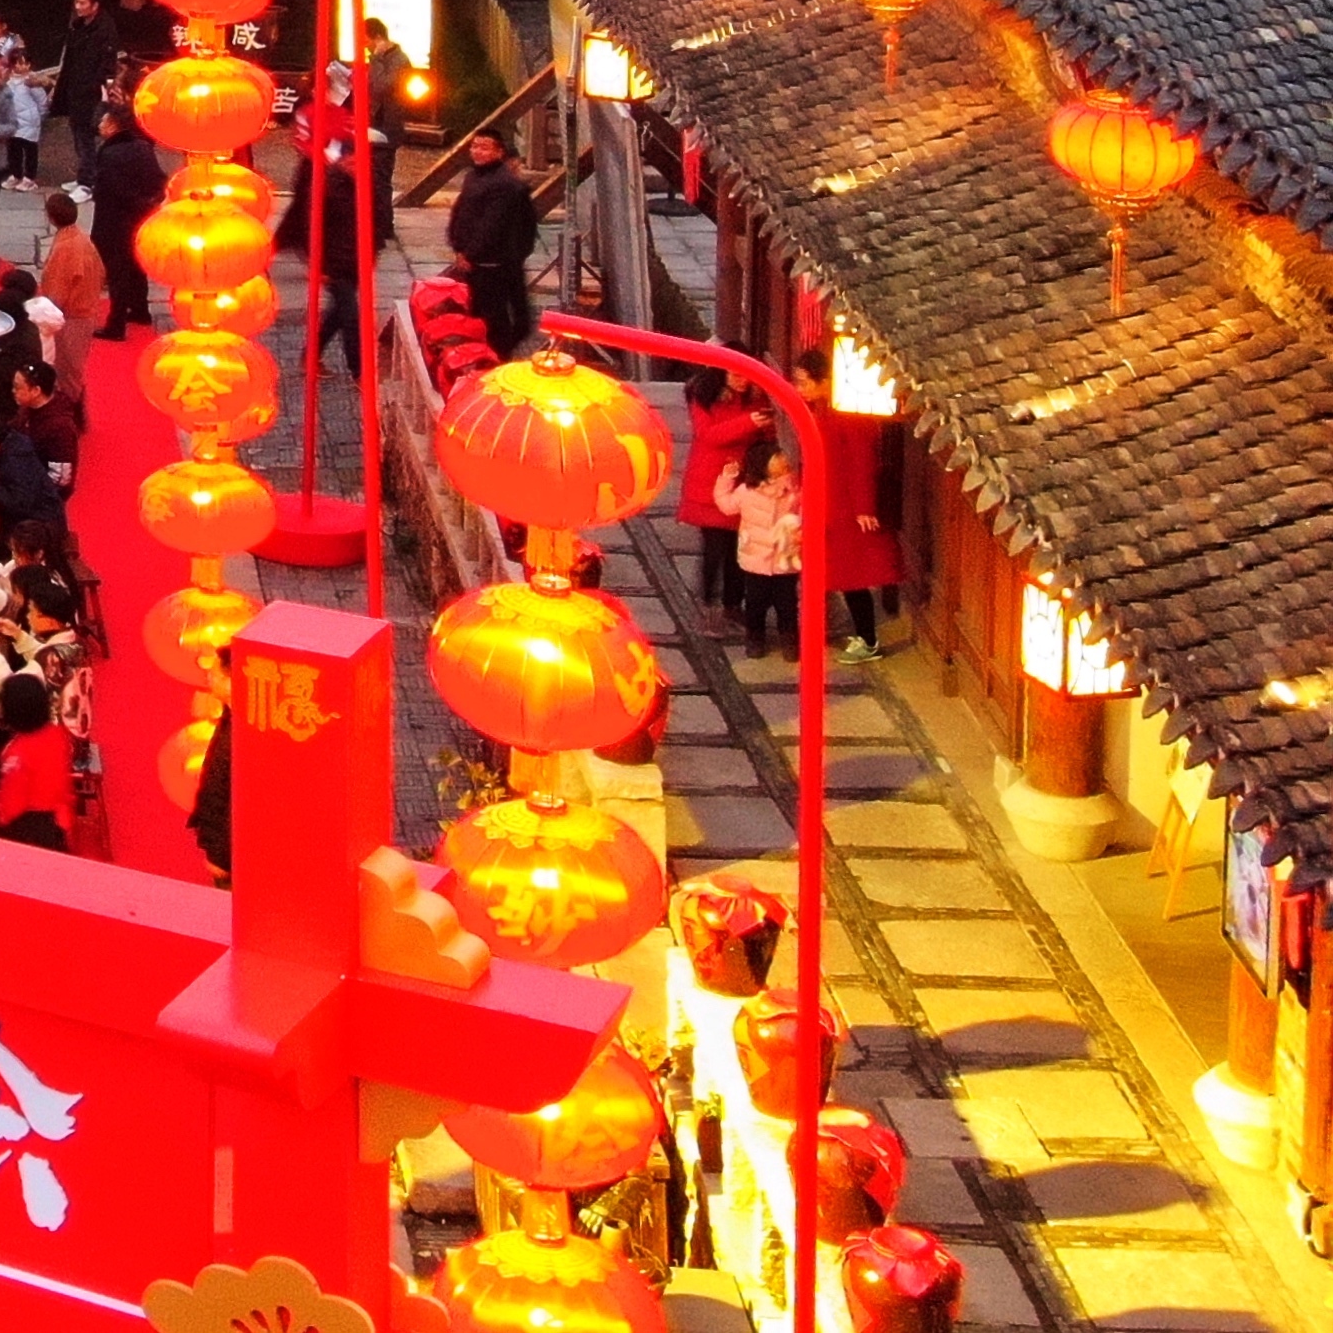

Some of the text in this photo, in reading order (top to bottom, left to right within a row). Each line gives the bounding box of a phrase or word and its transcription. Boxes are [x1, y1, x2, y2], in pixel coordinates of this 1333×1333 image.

[232, 22, 266, 51] 咸
[272, 87, 300, 114] 苦
[168, 362, 233, 413] 会
